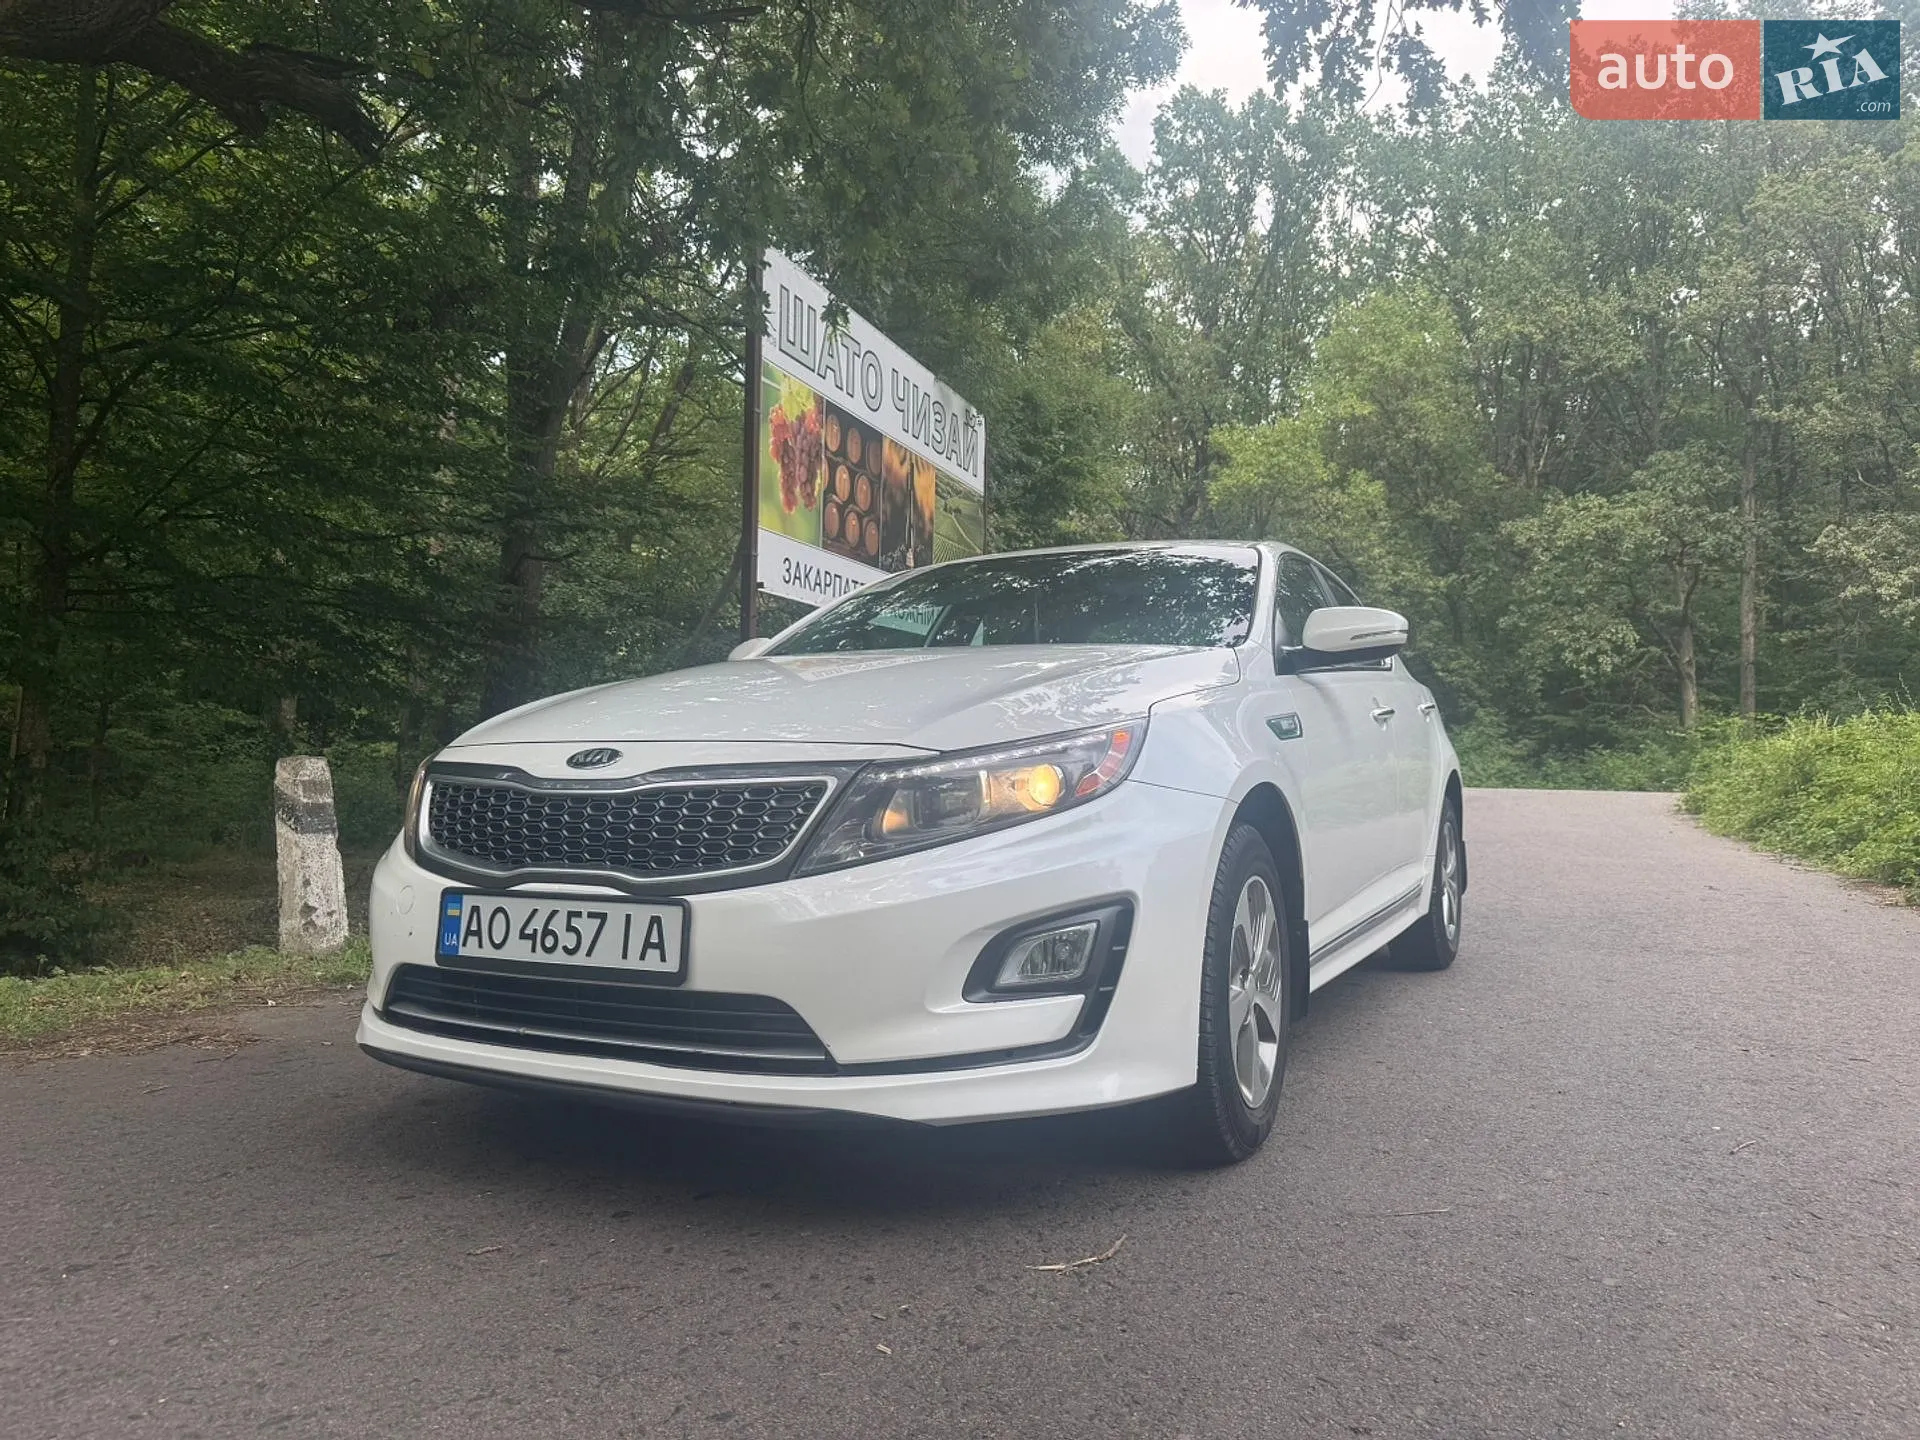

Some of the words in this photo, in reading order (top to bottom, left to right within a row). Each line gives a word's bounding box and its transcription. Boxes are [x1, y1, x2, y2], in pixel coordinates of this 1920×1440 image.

[778, 283, 883, 412] ШАТО
[890, 367, 979, 478] ЧИЗАЙ
[782, 557, 867, 598] ЗАКАРПАТ
[444, 931, 459, 947] UA
[461, 904, 511, 950] AO
[518, 907, 608, 958] 4657
[621, 912, 668, 963] IA
